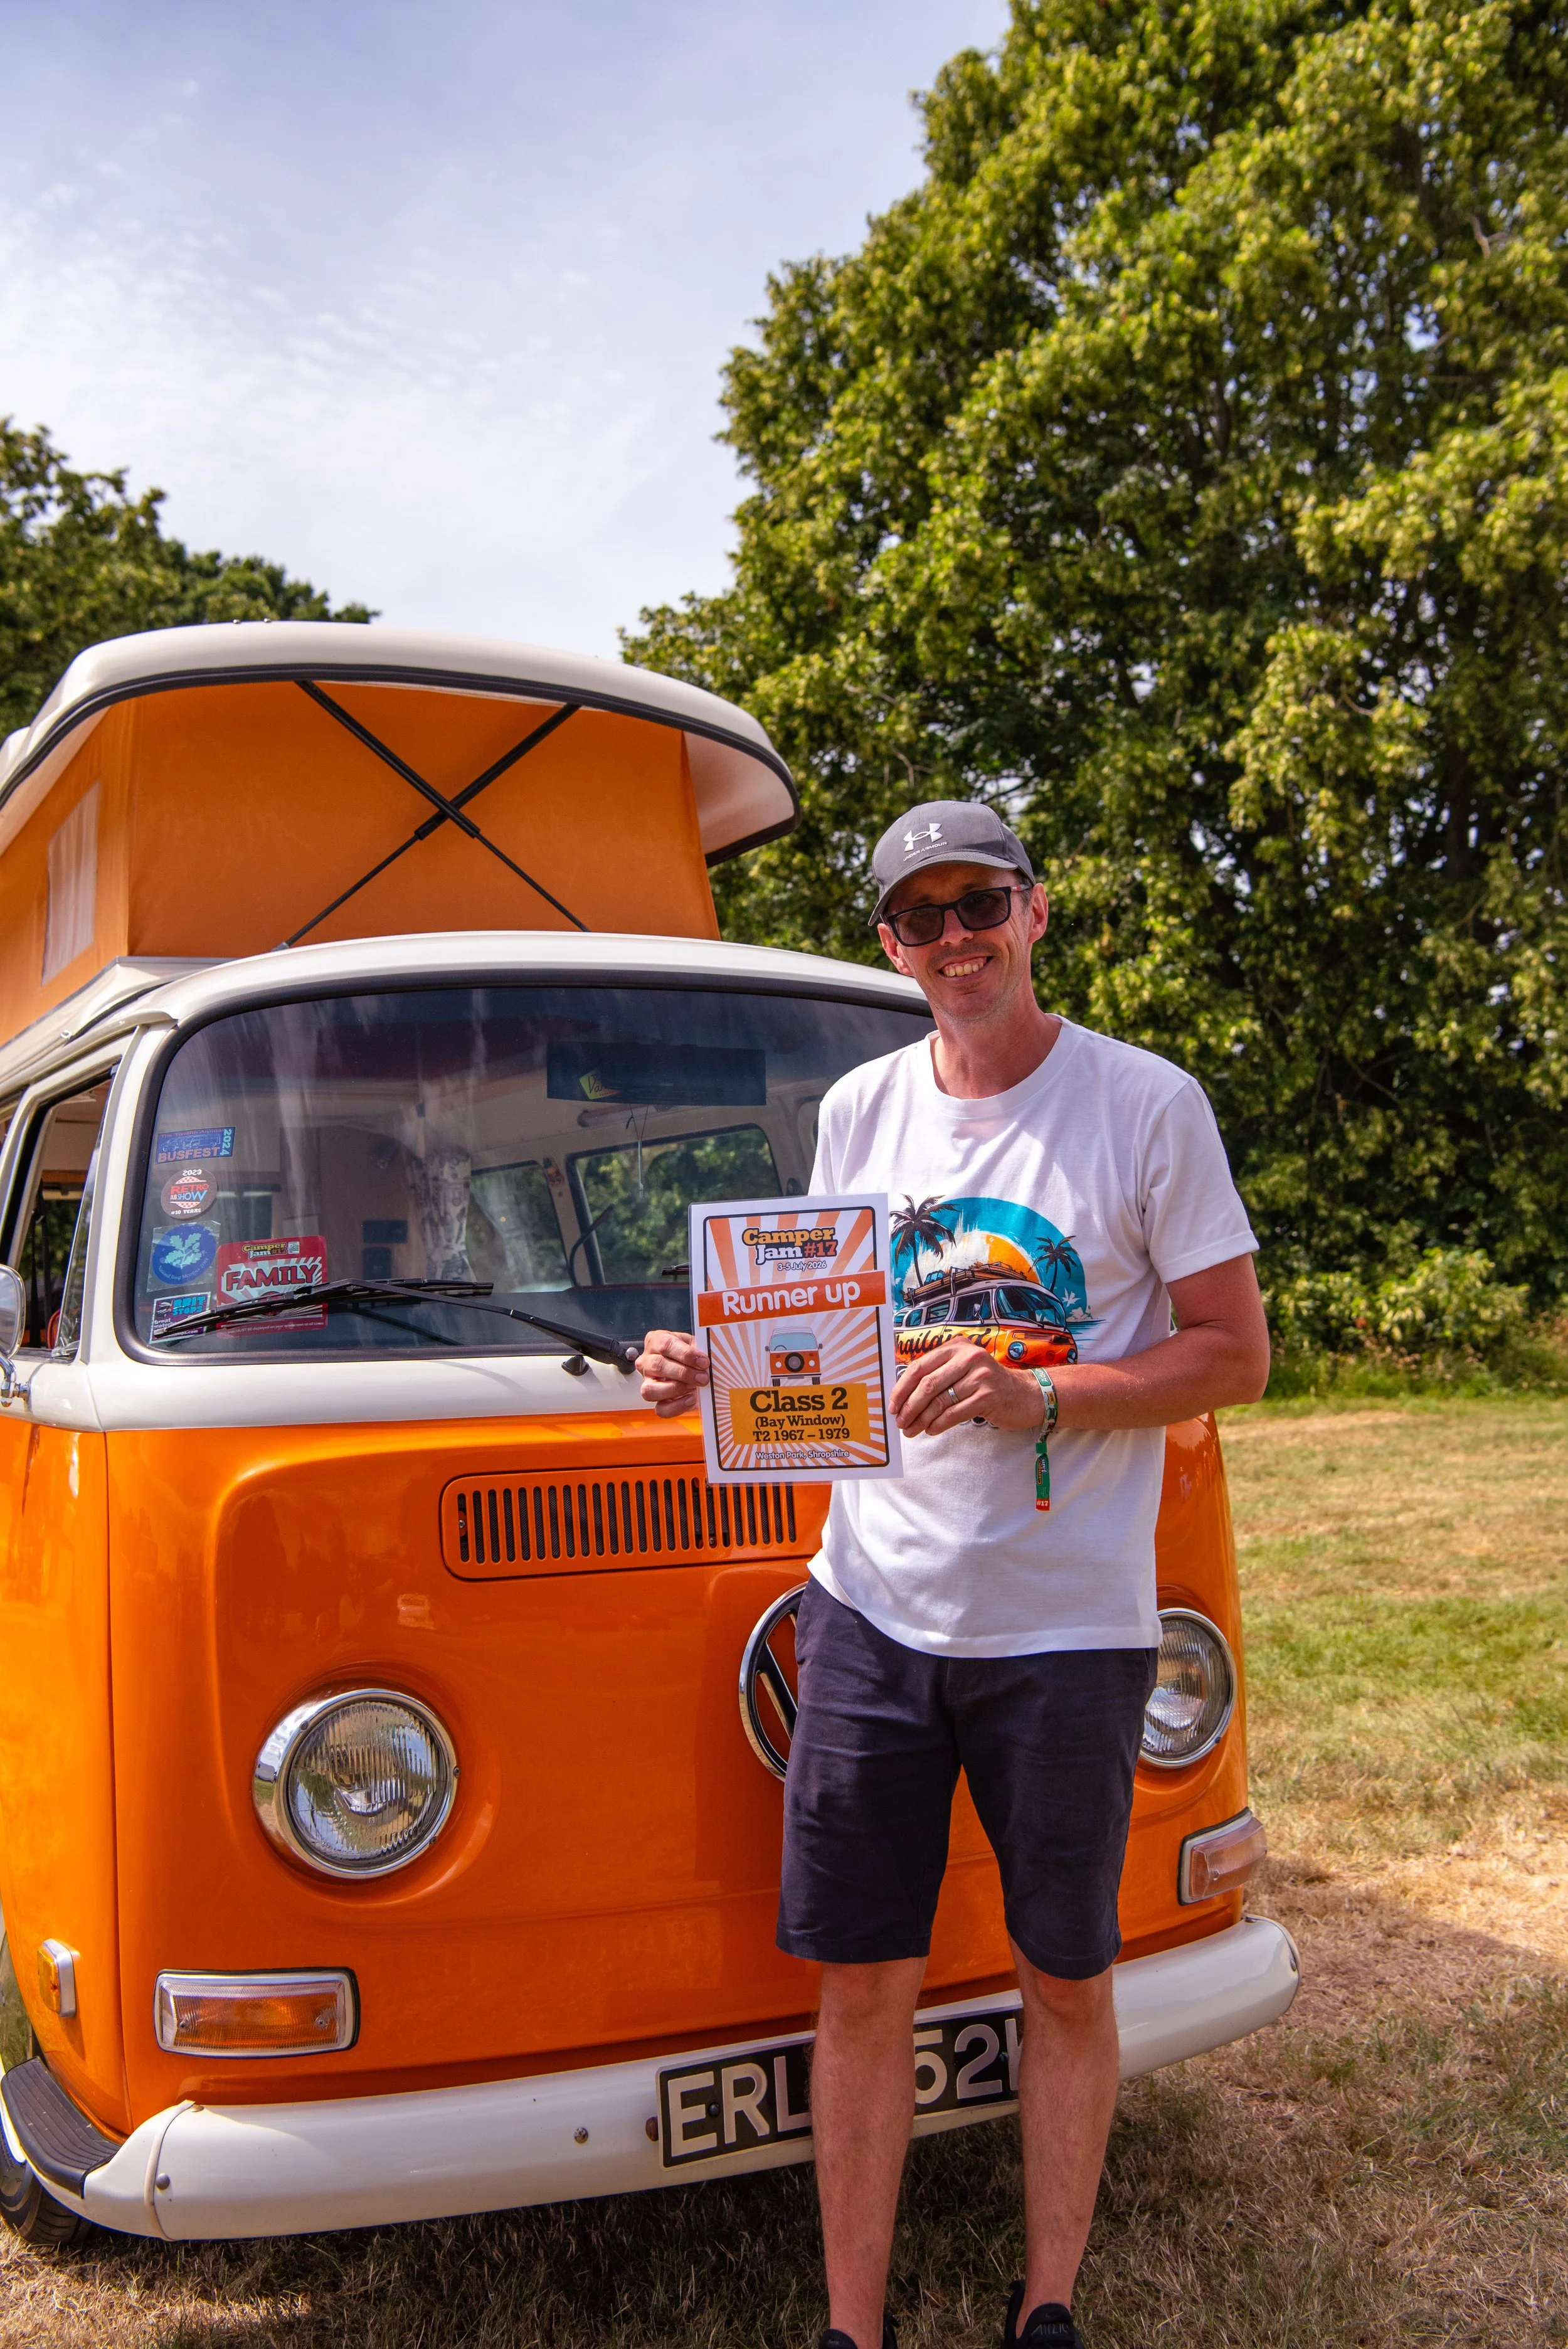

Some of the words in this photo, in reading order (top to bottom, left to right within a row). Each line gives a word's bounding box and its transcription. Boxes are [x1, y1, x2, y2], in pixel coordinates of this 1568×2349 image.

[903, 850, 921, 862] UNDER
[921, 841, 948, 852] ARMOUR
[220, 1128, 232, 1156] 2024
[158, 1147, 221, 1163] BUSFEST
[171, 1184, 209, 1195] RETRO
[177, 1190, 208, 1201] SHOW
[743, 1228, 834, 1246] Camper
[243, 1243, 287, 1252] Camper
[249, 1250, 271, 1259] Jam
[757, 1244, 803, 1264] Jam
[804, 1241, 837, 1257] #17
[778, 1263, 791, 1271] 3-5
[792, 1261, 807, 1271] July
[807, 1261, 827, 1270] 2026
[226, 1264, 319, 1291] FAMILY
[173, 1296, 206, 1310] BRIT
[722, 1285, 818, 1316] Runner
[825, 1281, 861, 1308] up
[172, 1305, 203, 1316] STOPS
[750, 1389, 825, 1413] Class
[831, 1387, 848, 1410] 2
[755, 1416, 785, 1430] (Bay
[786, 1414, 845, 1427] Window)
[753, 1430, 770, 1442] T2
[775, 1429, 805, 1441] 1967
[818, 1428, 850, 1440] 1979
[755, 1451, 785, 1460] Weston
[786, 1450, 807, 1460] Park,
[808, 1449, 849, 1460] Shropshire
[667, 2055, 813, 2158] ERL
